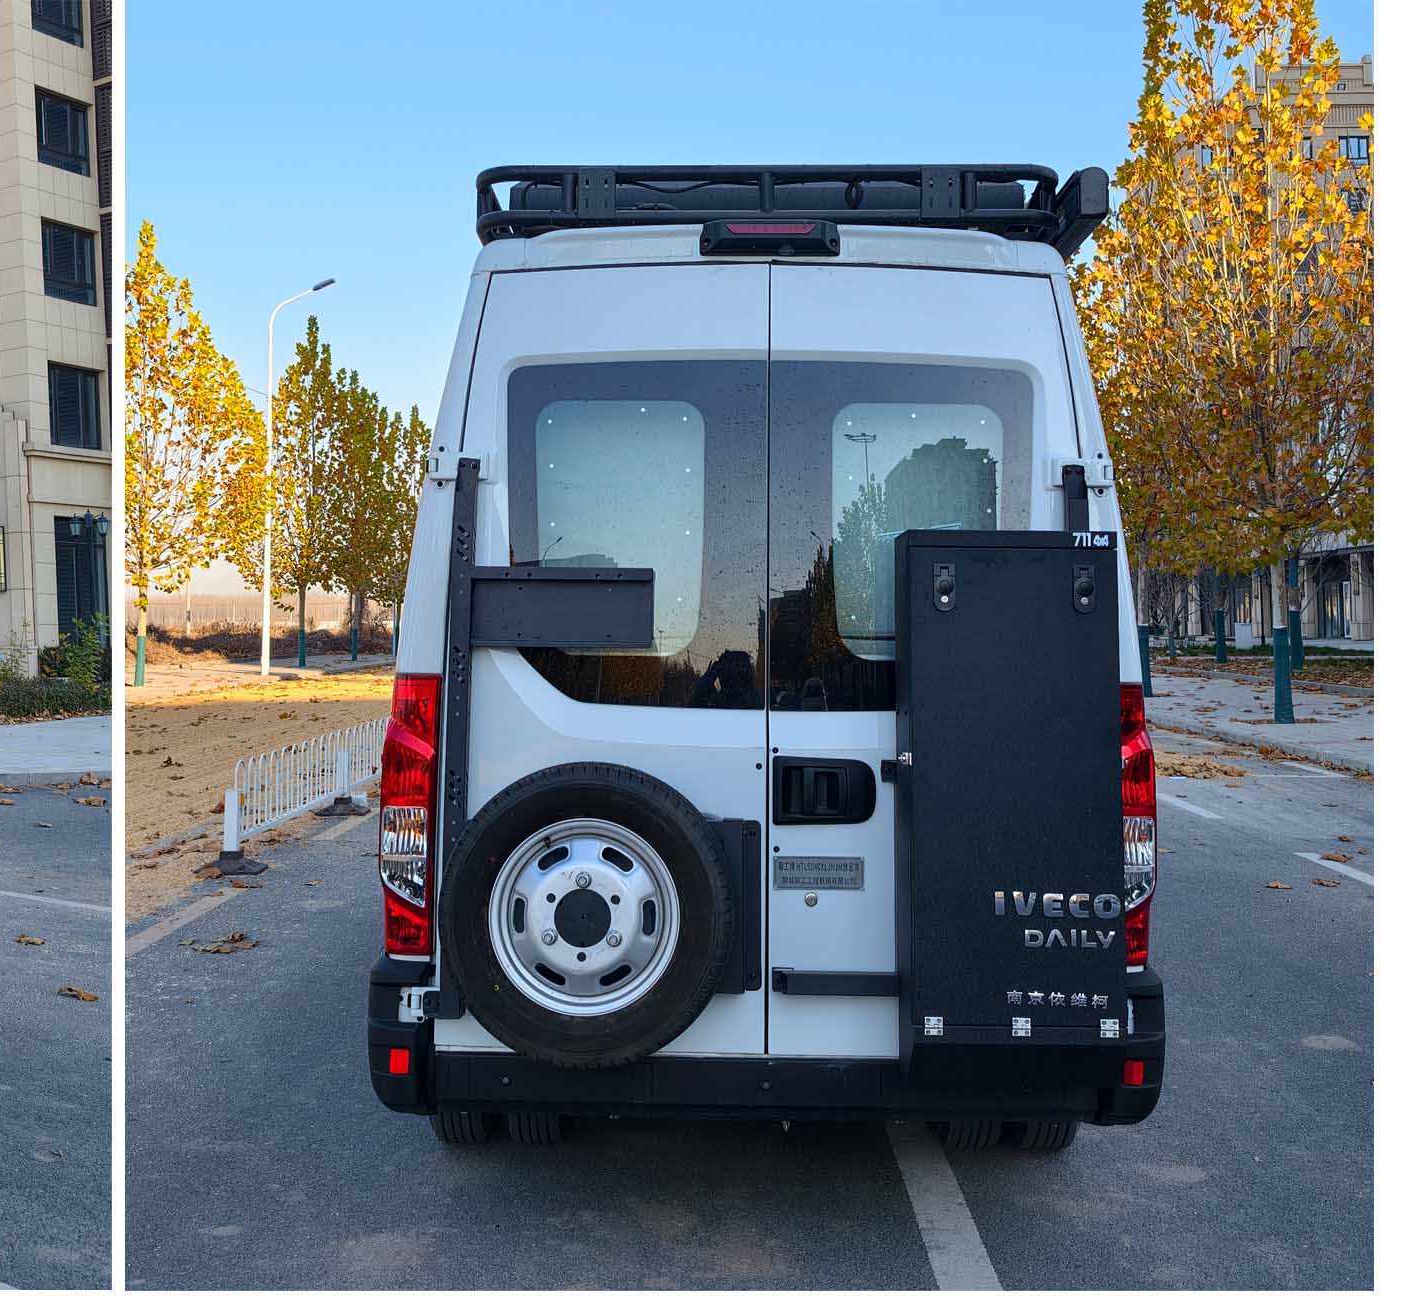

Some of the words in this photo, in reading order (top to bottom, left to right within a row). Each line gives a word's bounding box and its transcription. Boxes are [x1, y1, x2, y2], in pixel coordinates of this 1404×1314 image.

[1072, 532, 1092, 547] 711
[994, 891, 1122, 919] IVECO
[1024, 928, 1116, 949] DAILY
[1006, 989, 1109, 1009] 南京依维柯
